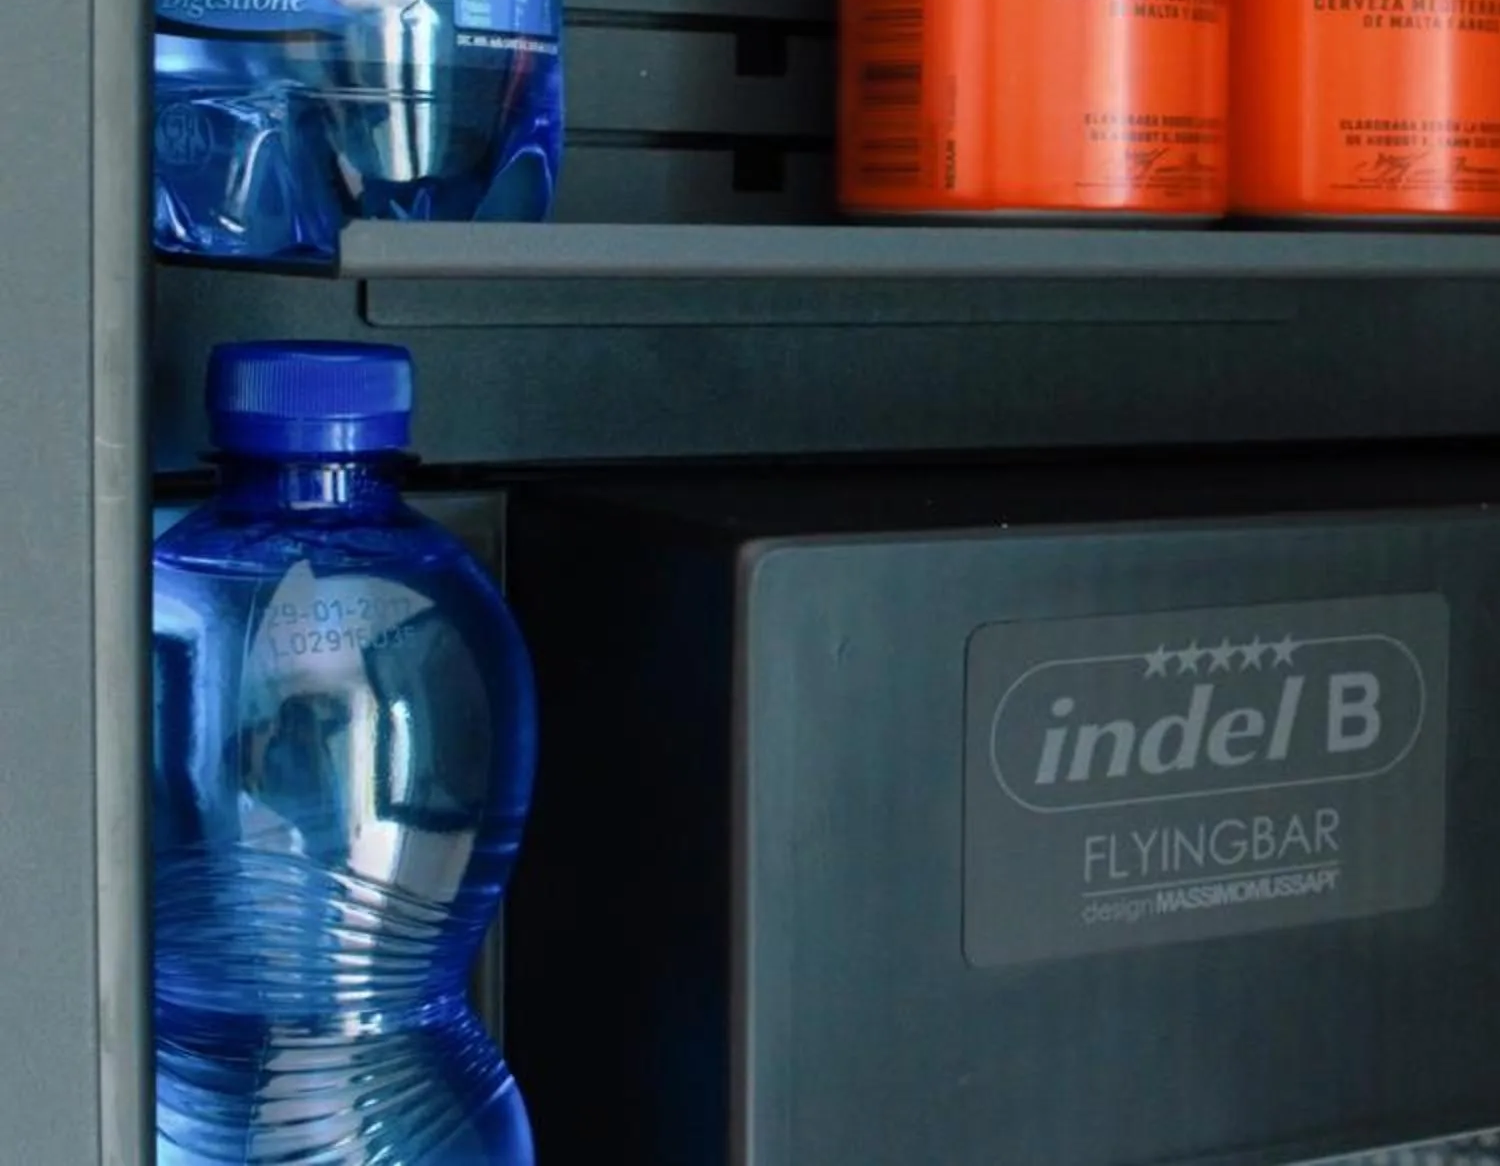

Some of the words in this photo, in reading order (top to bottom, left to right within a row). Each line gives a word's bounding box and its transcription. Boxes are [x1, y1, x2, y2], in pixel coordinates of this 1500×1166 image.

[1390, 15, 1441, 30] MALTA
[1035, 675, 1304, 785] indel
[1327, 670, 1381, 754] B
[1083, 807, 1341, 884] FLYINGBAR
